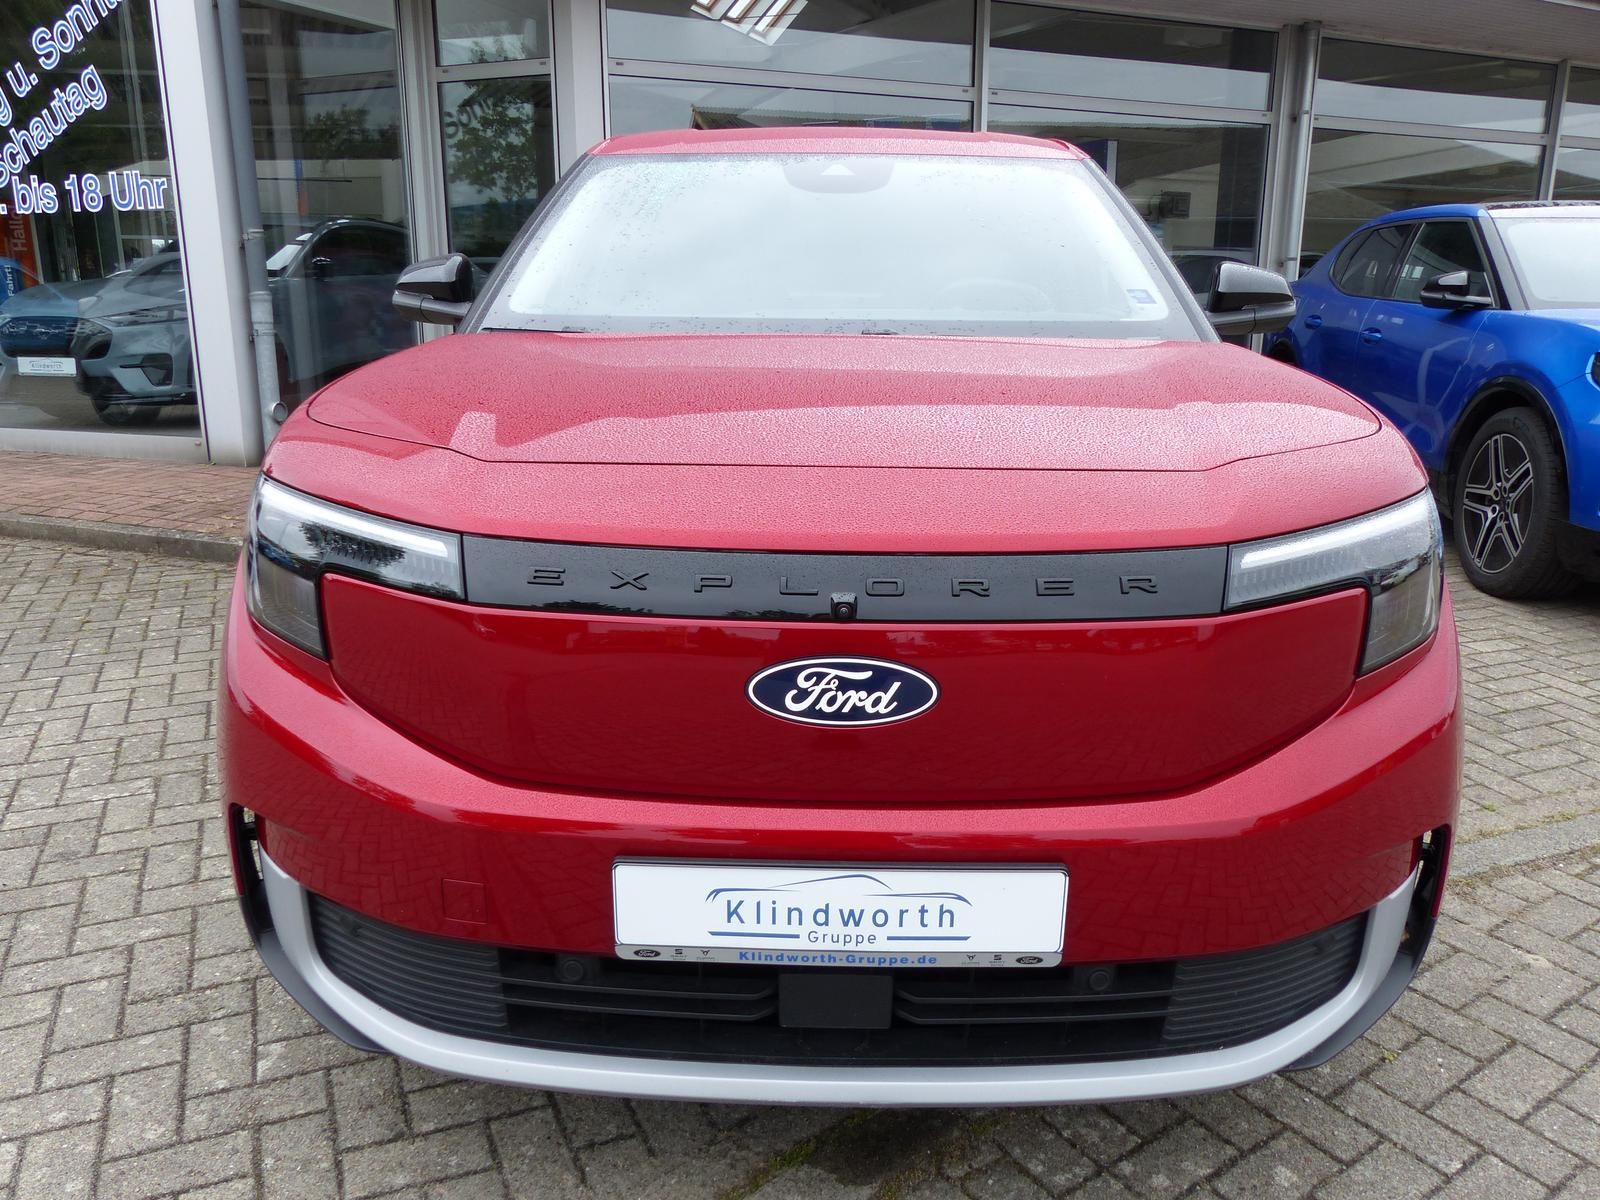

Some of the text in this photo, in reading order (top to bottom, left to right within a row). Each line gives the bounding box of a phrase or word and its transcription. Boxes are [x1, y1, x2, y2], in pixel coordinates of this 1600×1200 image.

[12, 170, 168, 214] bis 18 Uhr
[527, 566, 1158, 597] EXPLORER
[785, 667, 901, 714] Ford
[726, 899, 955, 928] Klindworth
[807, 930, 877, 947] Gruppe
[738, 951, 937, 966] Klindworth-Gruppe.de
